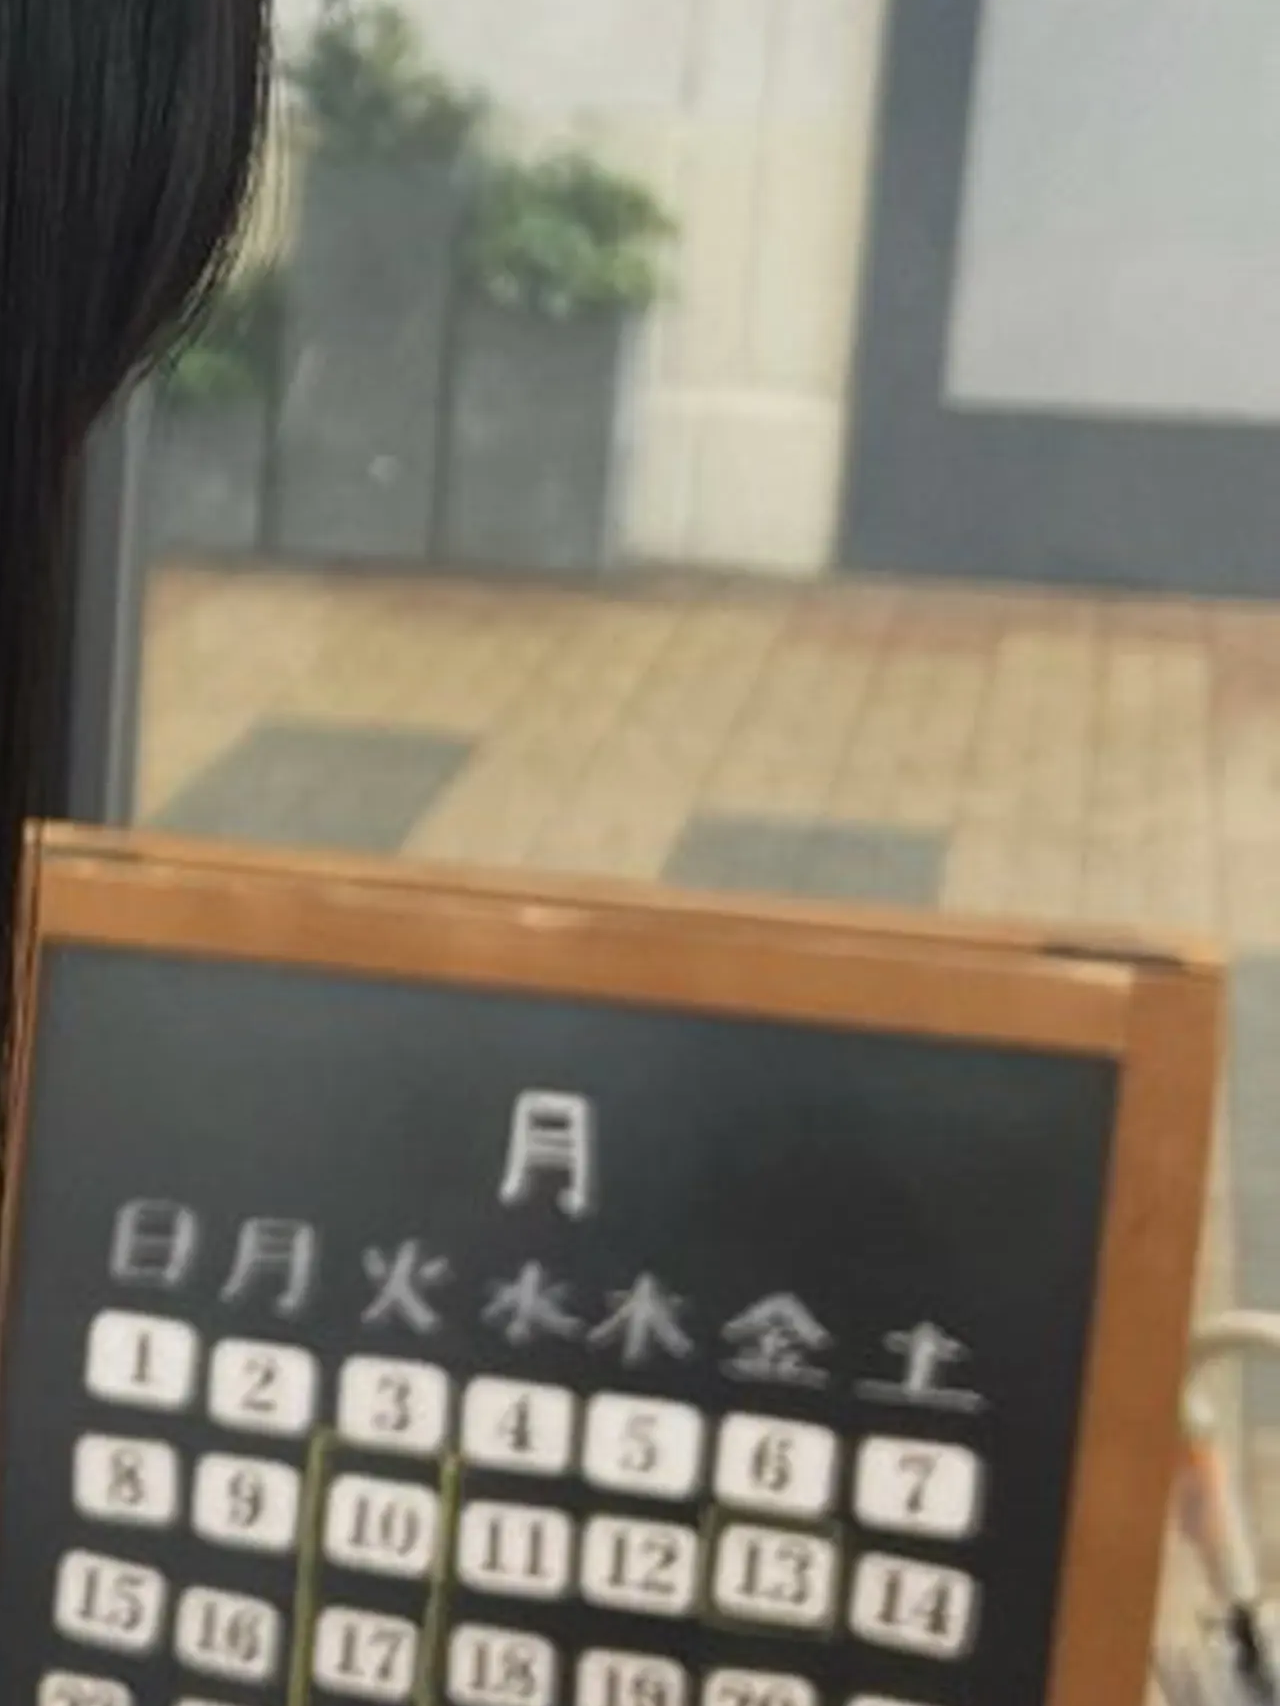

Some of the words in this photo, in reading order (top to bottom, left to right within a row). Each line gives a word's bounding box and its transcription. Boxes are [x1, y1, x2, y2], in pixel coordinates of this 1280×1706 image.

[498, 1090, 591, 1217] 月
[109, 1199, 195, 1285] 日
[220, 1216, 315, 1315] 月
[362, 1237, 453, 1334] 火
[481, 1260, 583, 1343] 水
[588, 1273, 693, 1364] 木
[720, 1293, 831, 1387] 金
[854, 1320, 987, 1411] 土
[239, 1356, 282, 1412] 2
[371, 1373, 413, 1432] 3
[497, 1393, 533, 1452] 4
[620, 1413, 659, 1474] 5
[751, 1431, 794, 1492] 6
[898, 1451, 937, 1513] 7
[108, 1448, 146, 1505] 8
[227, 1470, 268, 1527] 9
[347, 1496, 422, 1555] 10
[482, 1515, 553, 1579] 11
[605, 1530, 679, 1594] 12
[737, 1538, 811, 1606] 13
[880, 1569, 952, 1636] 14
[75, 1566, 146, 1631] 15
[195, 1600, 262, 1664] 16
[336, 1625, 404, 1682] 17
[468, 1640, 537, 1695] 18
